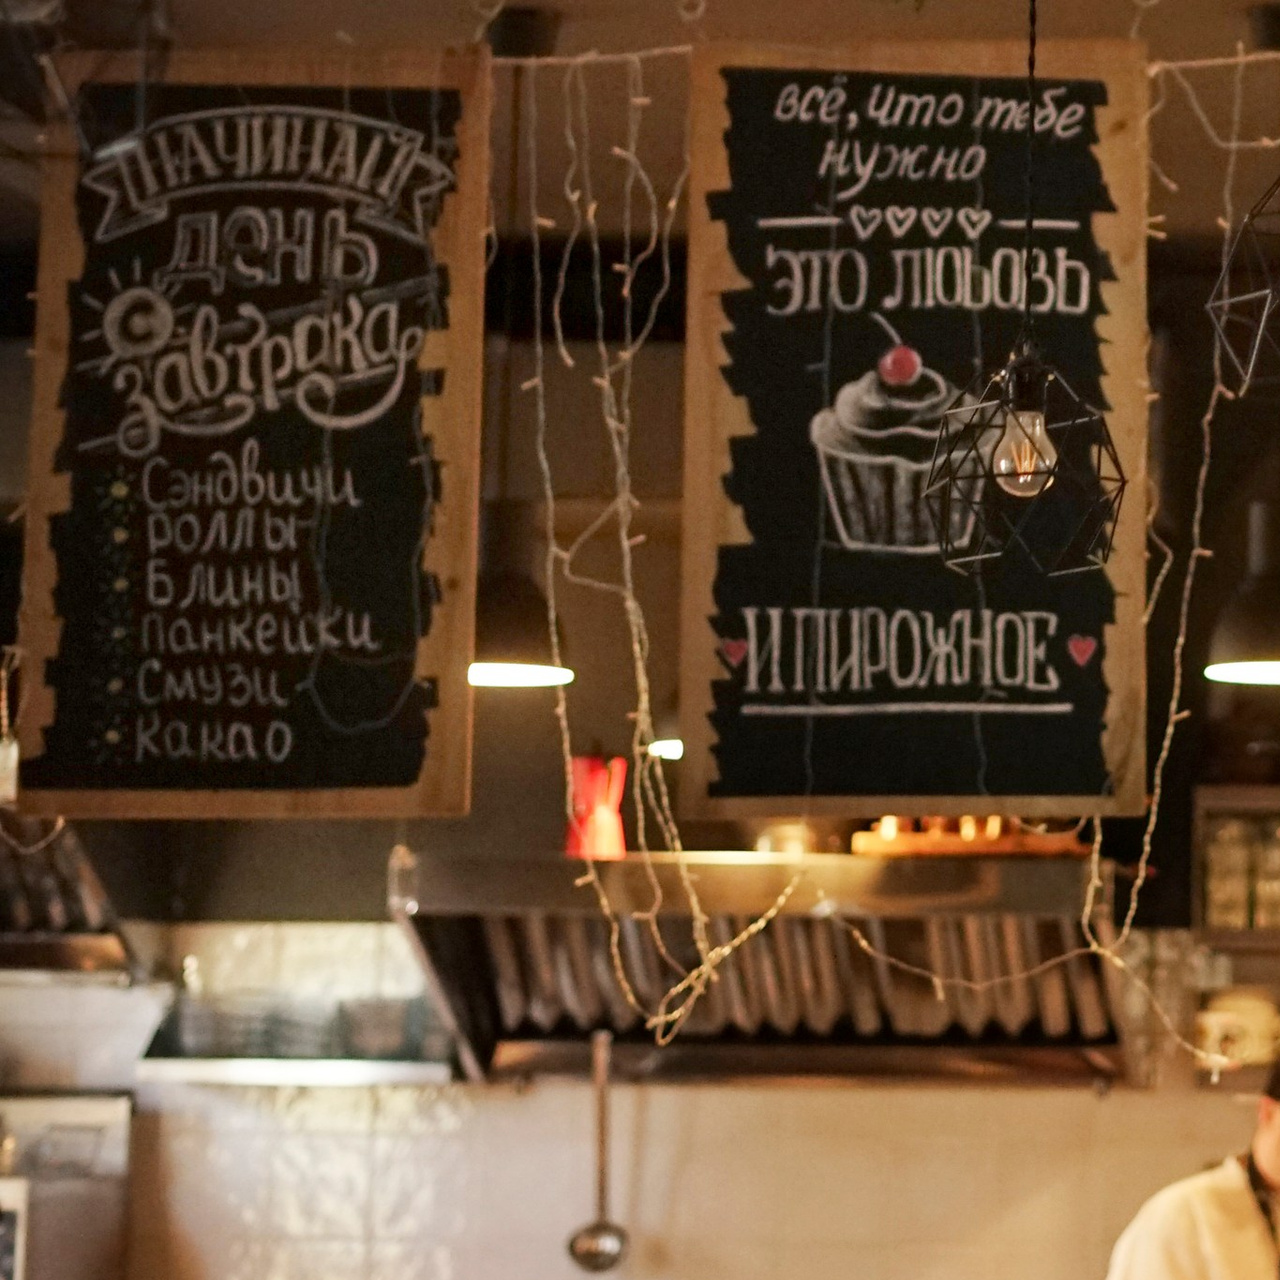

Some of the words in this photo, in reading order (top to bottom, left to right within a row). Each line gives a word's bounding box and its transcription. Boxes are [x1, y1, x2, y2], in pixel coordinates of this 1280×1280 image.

[132, 116, 416, 198] НАЧИНАЙ
[818, 139, 987, 201] нужно
[765, 244, 869, 316] ЭТО
[141, 438, 362, 508] Сэндвичи
[136, 657, 289, 707] Смузи
[741, 606, 784, 694] И
[792, 606, 1061, 694] ПИРОЖНОЕ
[134, 711, 293, 763] Какао
